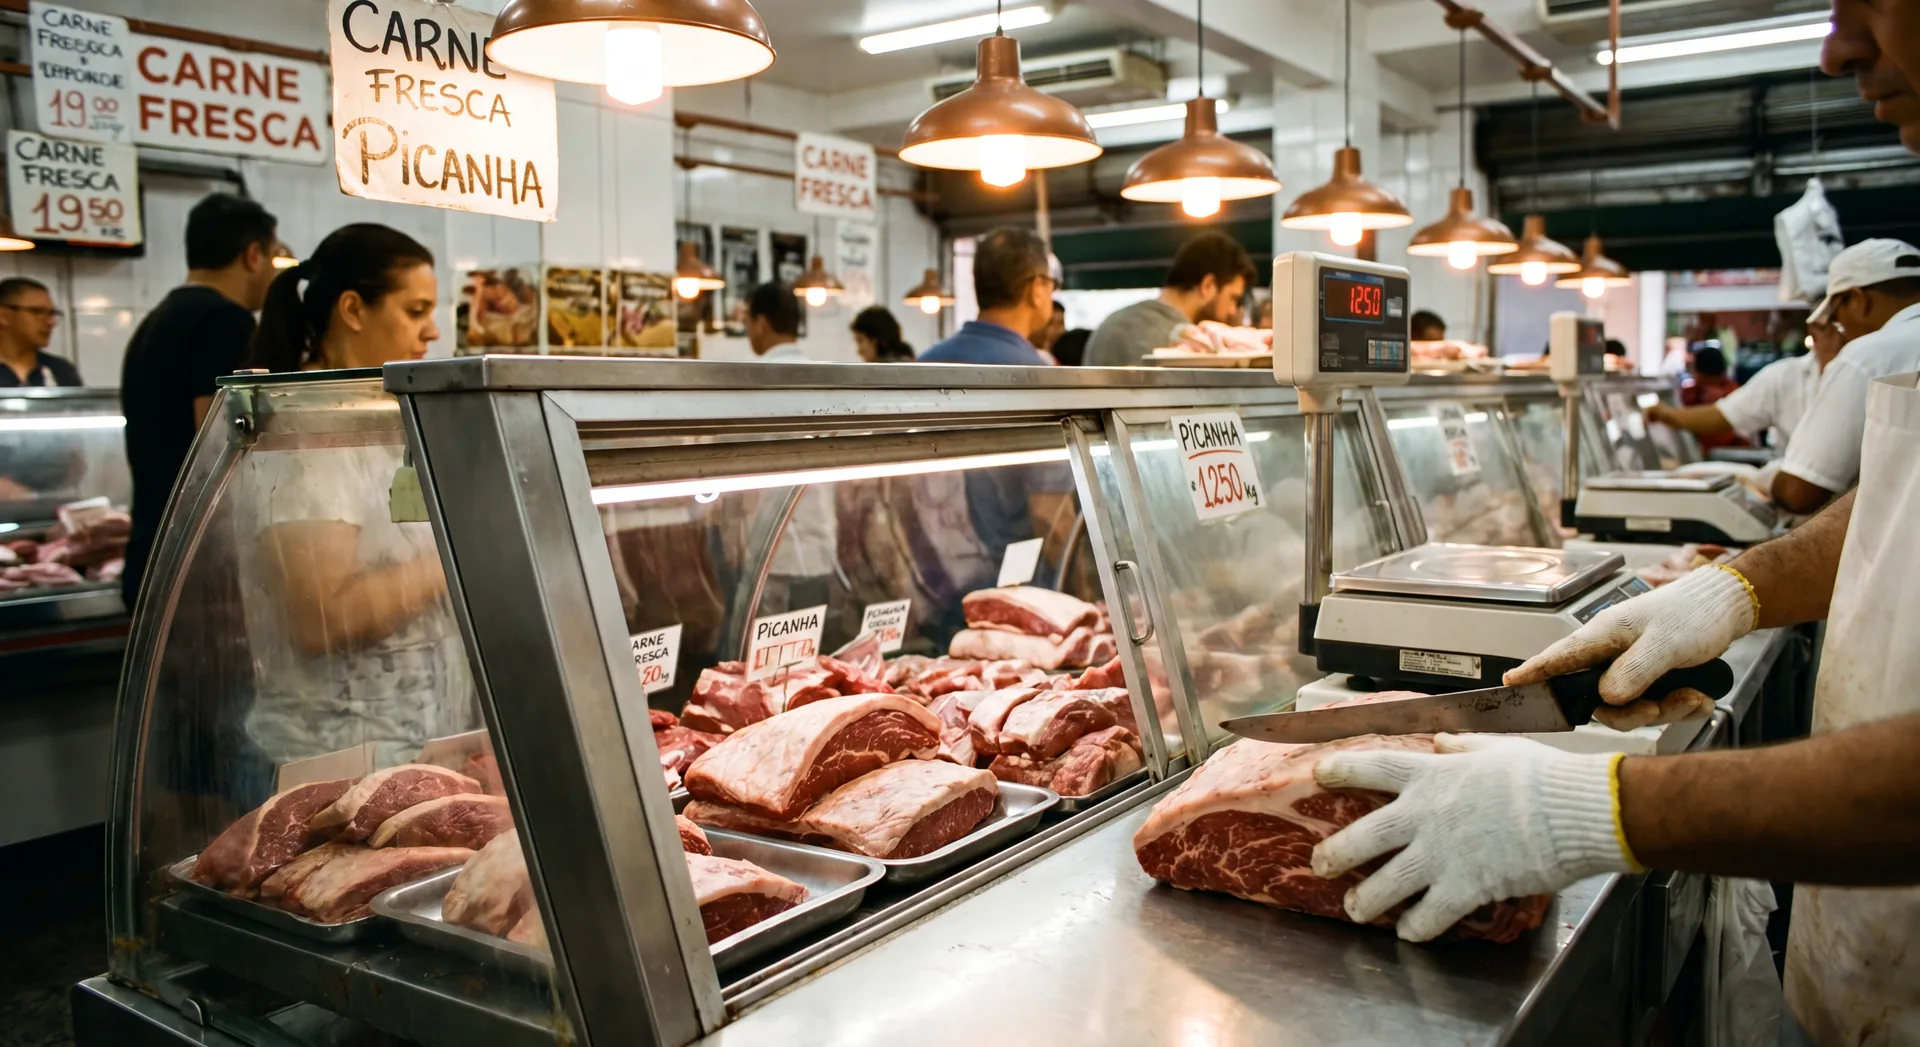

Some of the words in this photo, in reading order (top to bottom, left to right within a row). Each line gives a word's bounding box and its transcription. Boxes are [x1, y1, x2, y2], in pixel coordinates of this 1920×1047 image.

[42, 9, 113, 37] CARNE
[137, 46, 301, 102] CARNE
[365, 69, 511, 127] FRESCA
[139, 95, 321, 151] FRESCA
[15, 137, 105, 167] CARNE
[802, 145, 868, 179] CARNE
[21, 165, 120, 192] FRESCA
[800, 178, 873, 208] FRESCA
[1350, 285, 1381, 316] 1250
[633, 633, 665, 650] ARNE
[635, 647, 669, 664] RESCA
